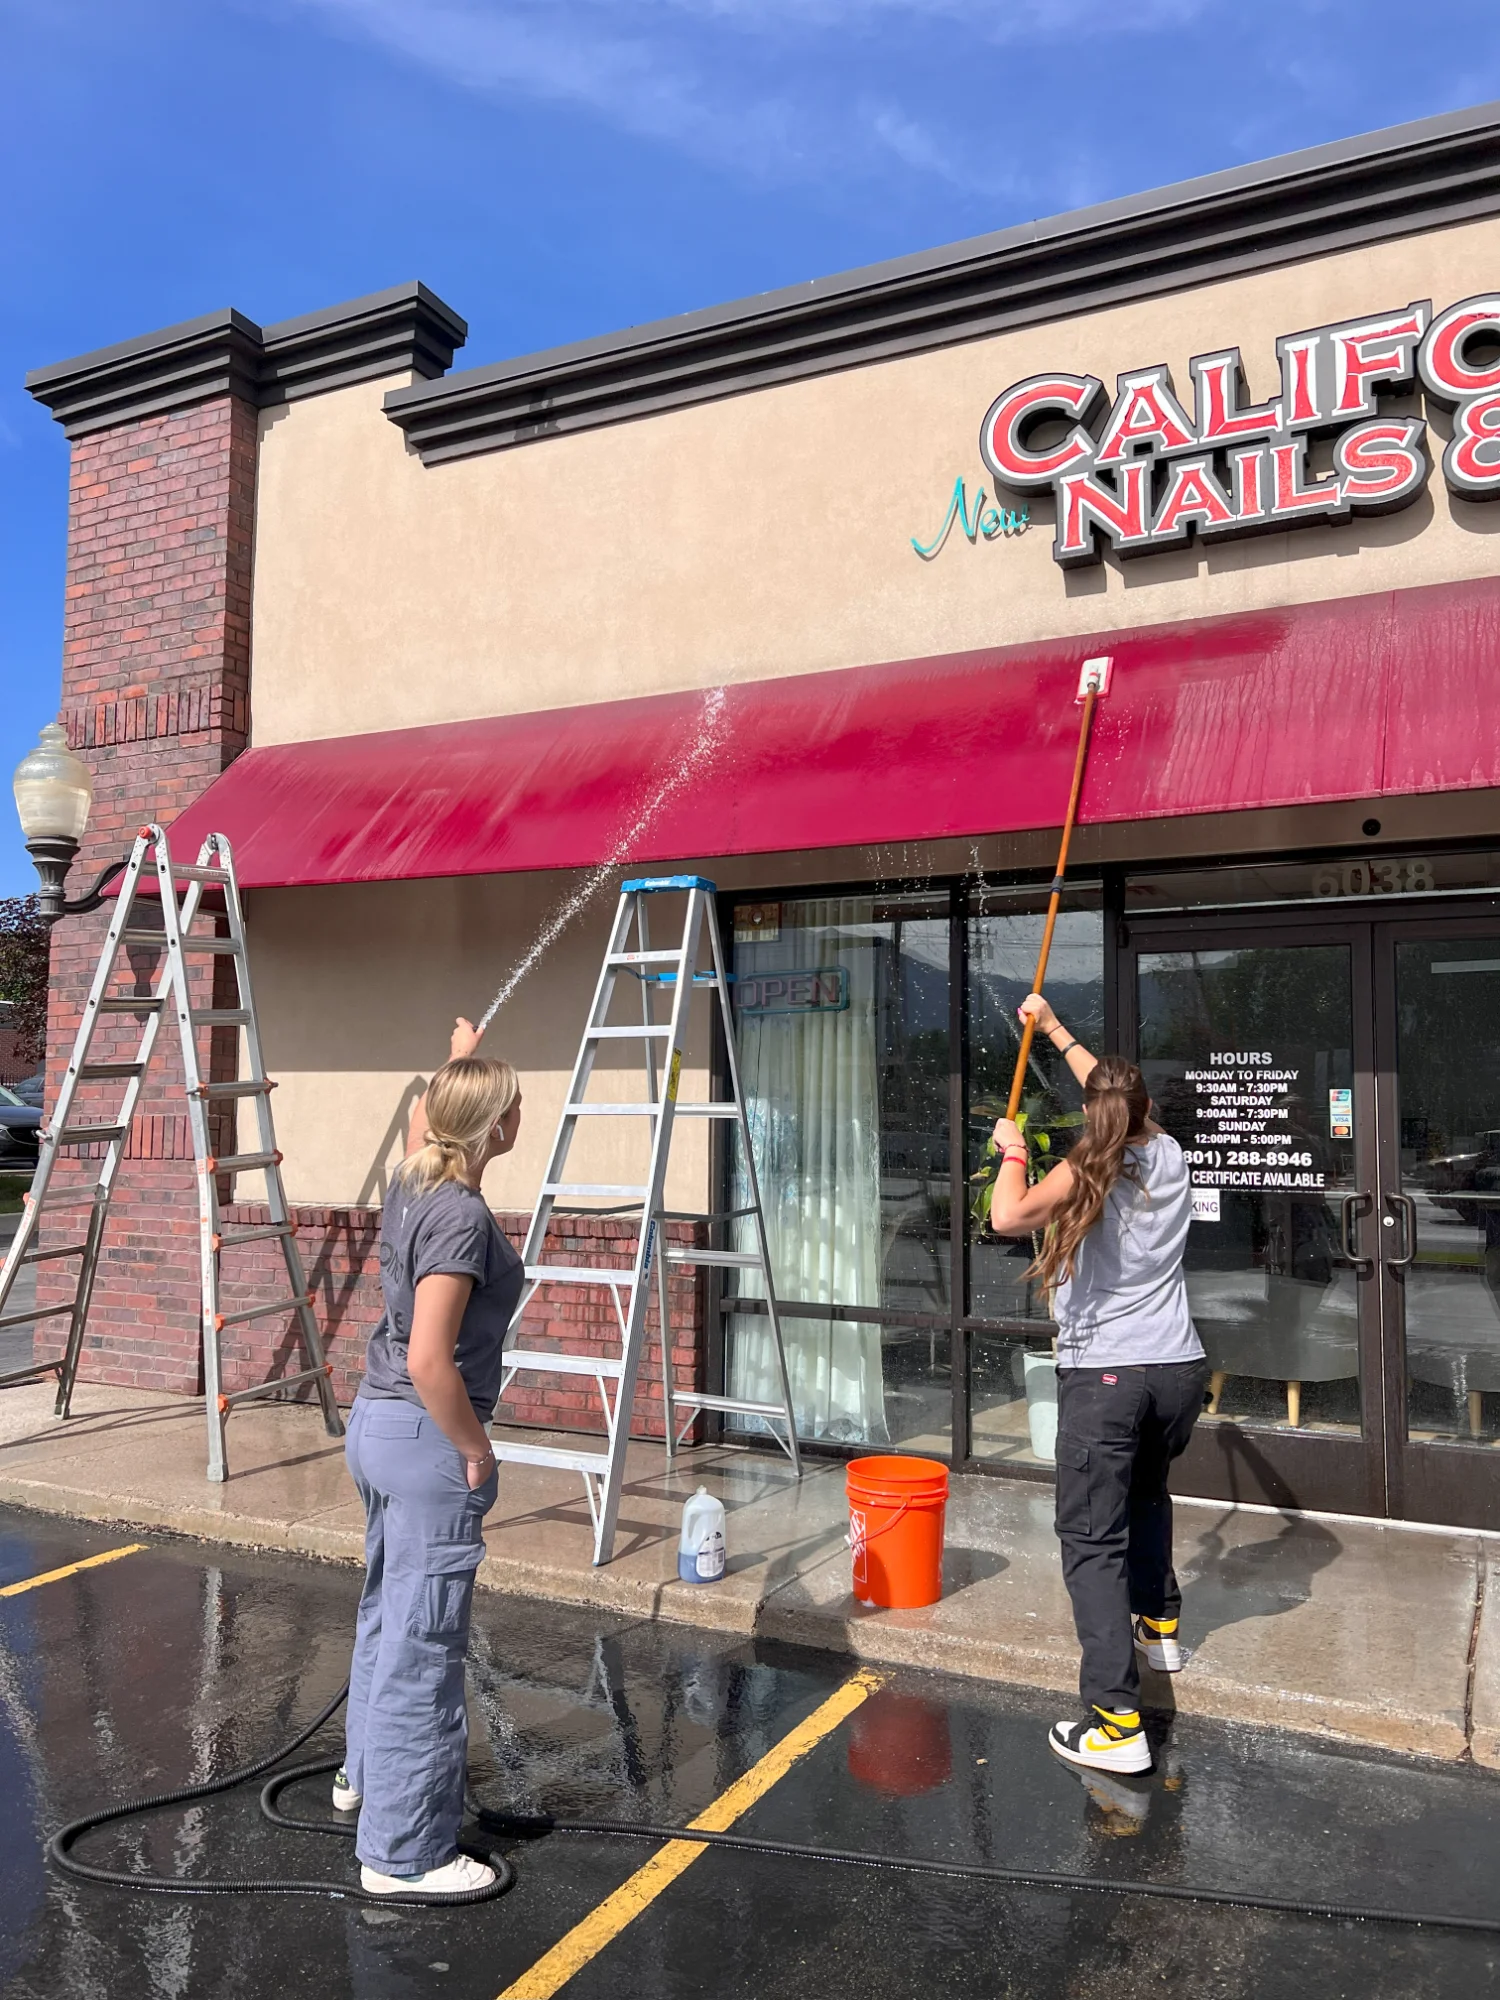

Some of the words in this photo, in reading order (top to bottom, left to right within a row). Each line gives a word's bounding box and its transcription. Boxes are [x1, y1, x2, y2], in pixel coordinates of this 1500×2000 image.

[1058, 421, 1420, 554] NAILS
[910, 475, 1030, 553] New
[1312, 858, 1435, 897] 6038
[734, 974, 840, 1008] OPEN
[1210, 1052, 1273, 1065] HOURS
[1185, 1070, 1234, 1081] MONDAY
[1237, 1070, 1254, 1081] TO
[1255, 1070, 1299, 1081] FRIDAY
[1196, 1082, 1237, 1093] 9:30AM
[1246, 1082, 1289, 1093] 7:30PM
[1210, 1095, 1273, 1106] SATURDAY
[1196, 1108, 1238, 1119] 9:00AM
[1247, 1108, 1289, 1119] 7:30PM
[1218, 1121, 1266, 1132] SUNDAY
[1194, 1133, 1241, 1145] 12:00PM
[1250, 1134, 1292, 1145] 5:00PM
[1226, 1151, 1313, 1167] 288-8946
[1192, 1170, 1261, 1185] CERTIFICATE
[1262, 1172, 1325, 1188] AVAILABLE
